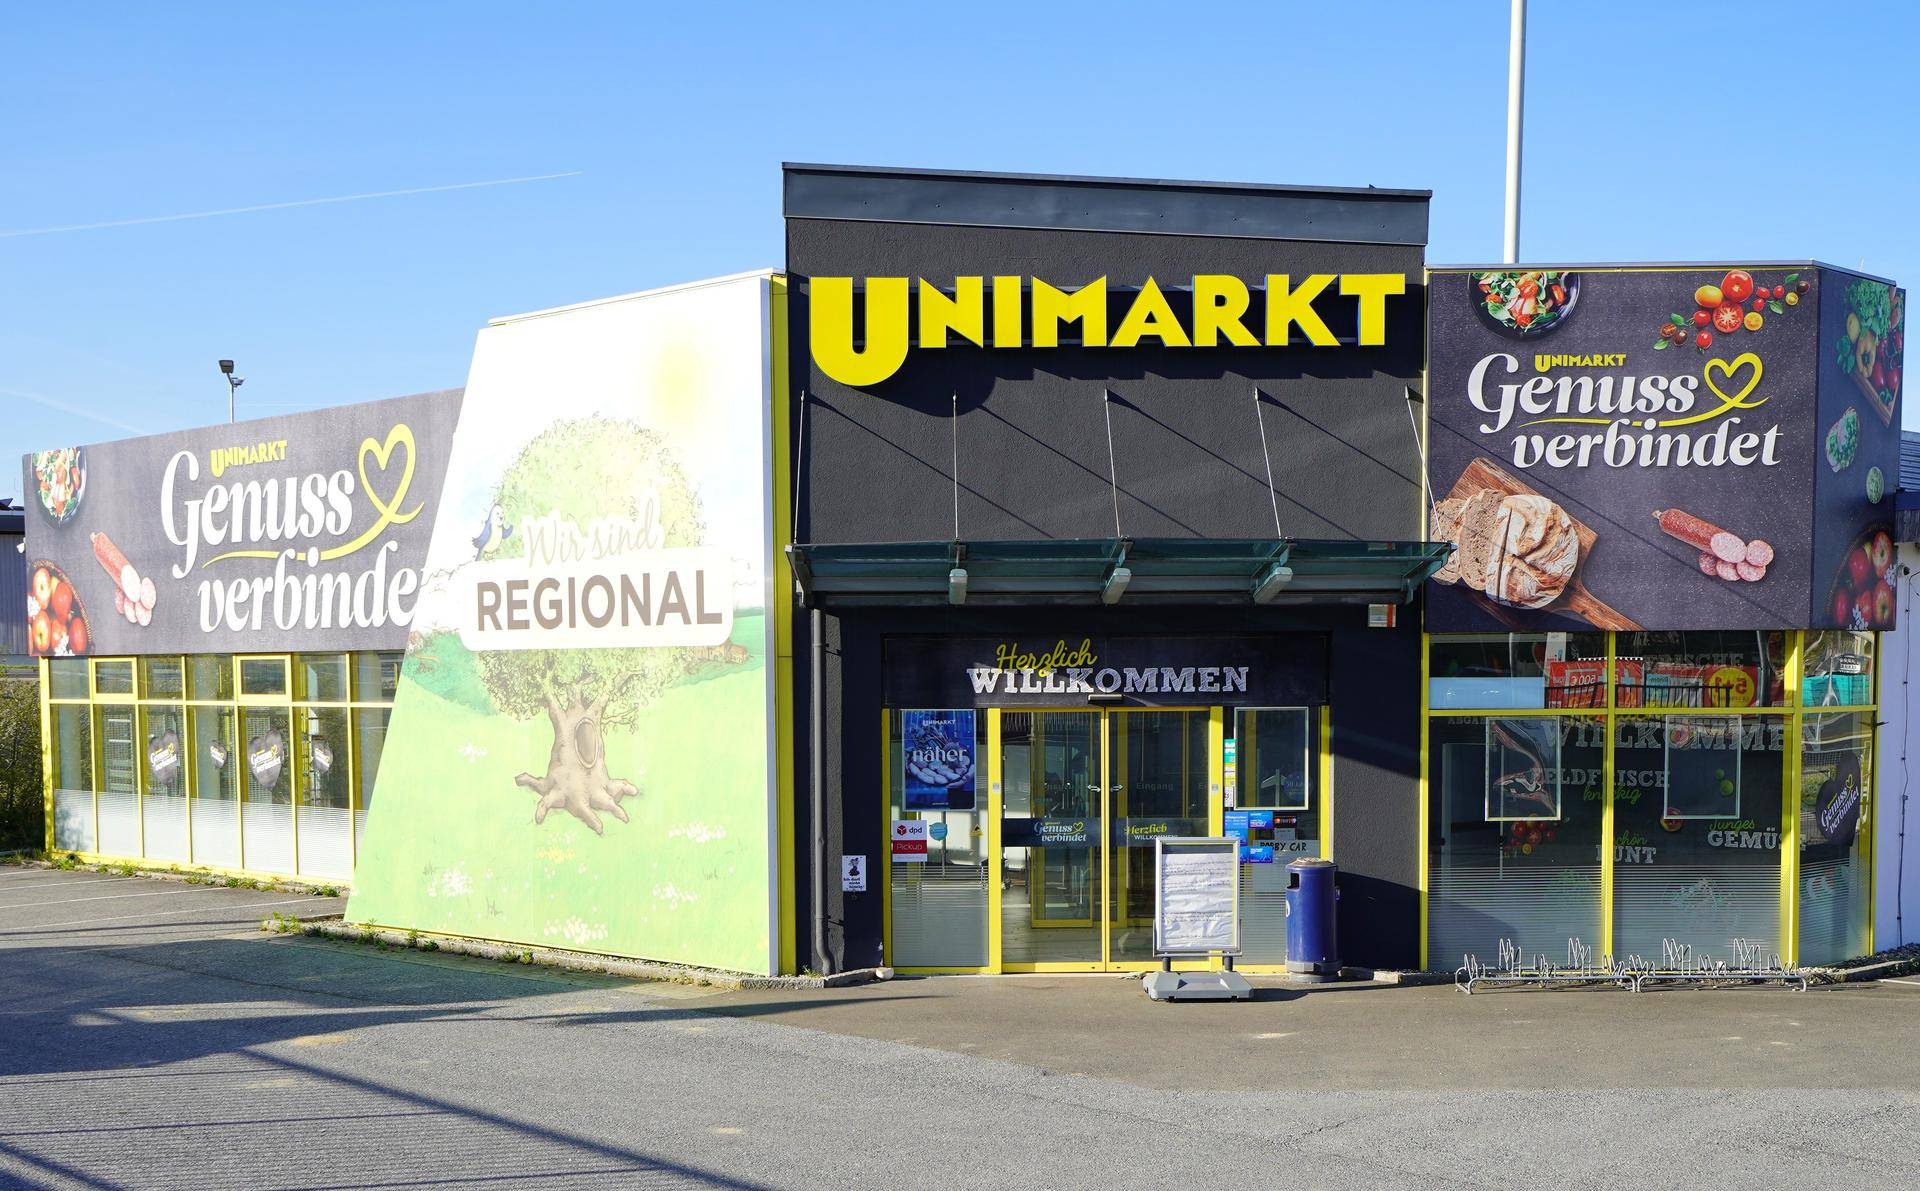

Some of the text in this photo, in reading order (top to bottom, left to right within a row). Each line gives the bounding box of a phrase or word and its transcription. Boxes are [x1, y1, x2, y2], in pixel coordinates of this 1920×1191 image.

[809, 273, 1406, 388] UNIMARKT
[1534, 353, 1627, 373] UNIMARKT
[1467, 353, 1699, 434] Genuss
[1510, 416, 1785, 468] verbindet
[210, 439, 288, 478] UNIMARKT
[160, 450, 355, 579] Genuss
[526, 497, 659, 568] Wir sind
[197, 540, 424, 633] verbinde
[476, 569, 723, 632] REGIONAL
[996, 638, 1098, 678] Herzlich
[966, 665, 1249, 694] WILLKOMMEN
[912, 745, 967, 763] näher
[1528, 768, 1670, 789] ELDFISCH
[1583, 784, 1642, 805] knkig
[908, 826, 923, 835] dpd
[1034, 821, 1073, 836] Genuss
[1041, 833, 1087, 842] verbindet
[896, 842, 923, 852] Pickup
[1289, 842, 1307, 852] CAR
